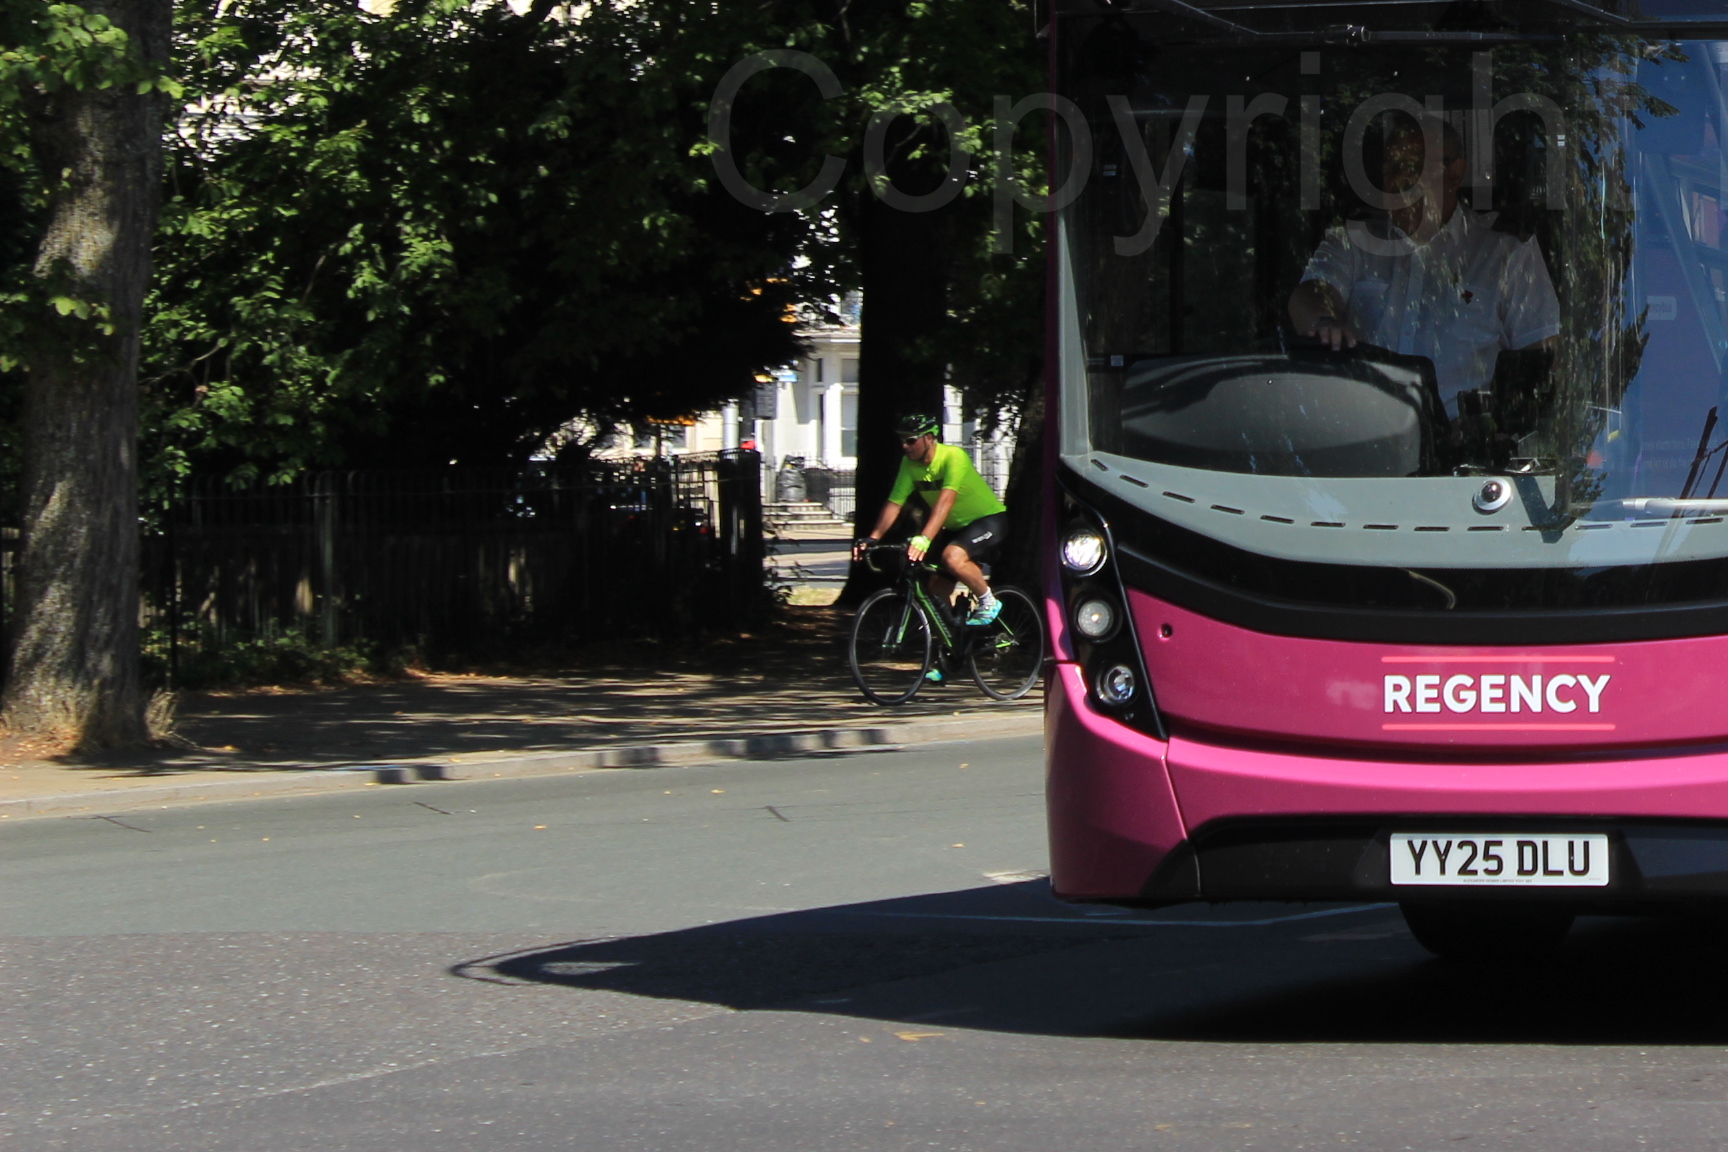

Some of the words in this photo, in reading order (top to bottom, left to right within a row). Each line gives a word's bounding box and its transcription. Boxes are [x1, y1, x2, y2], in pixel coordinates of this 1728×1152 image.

[1383, 673, 1611, 714] REGENCY
[1407, 840, 1503, 876] YY25
[1516, 840, 1590, 876] DLU
